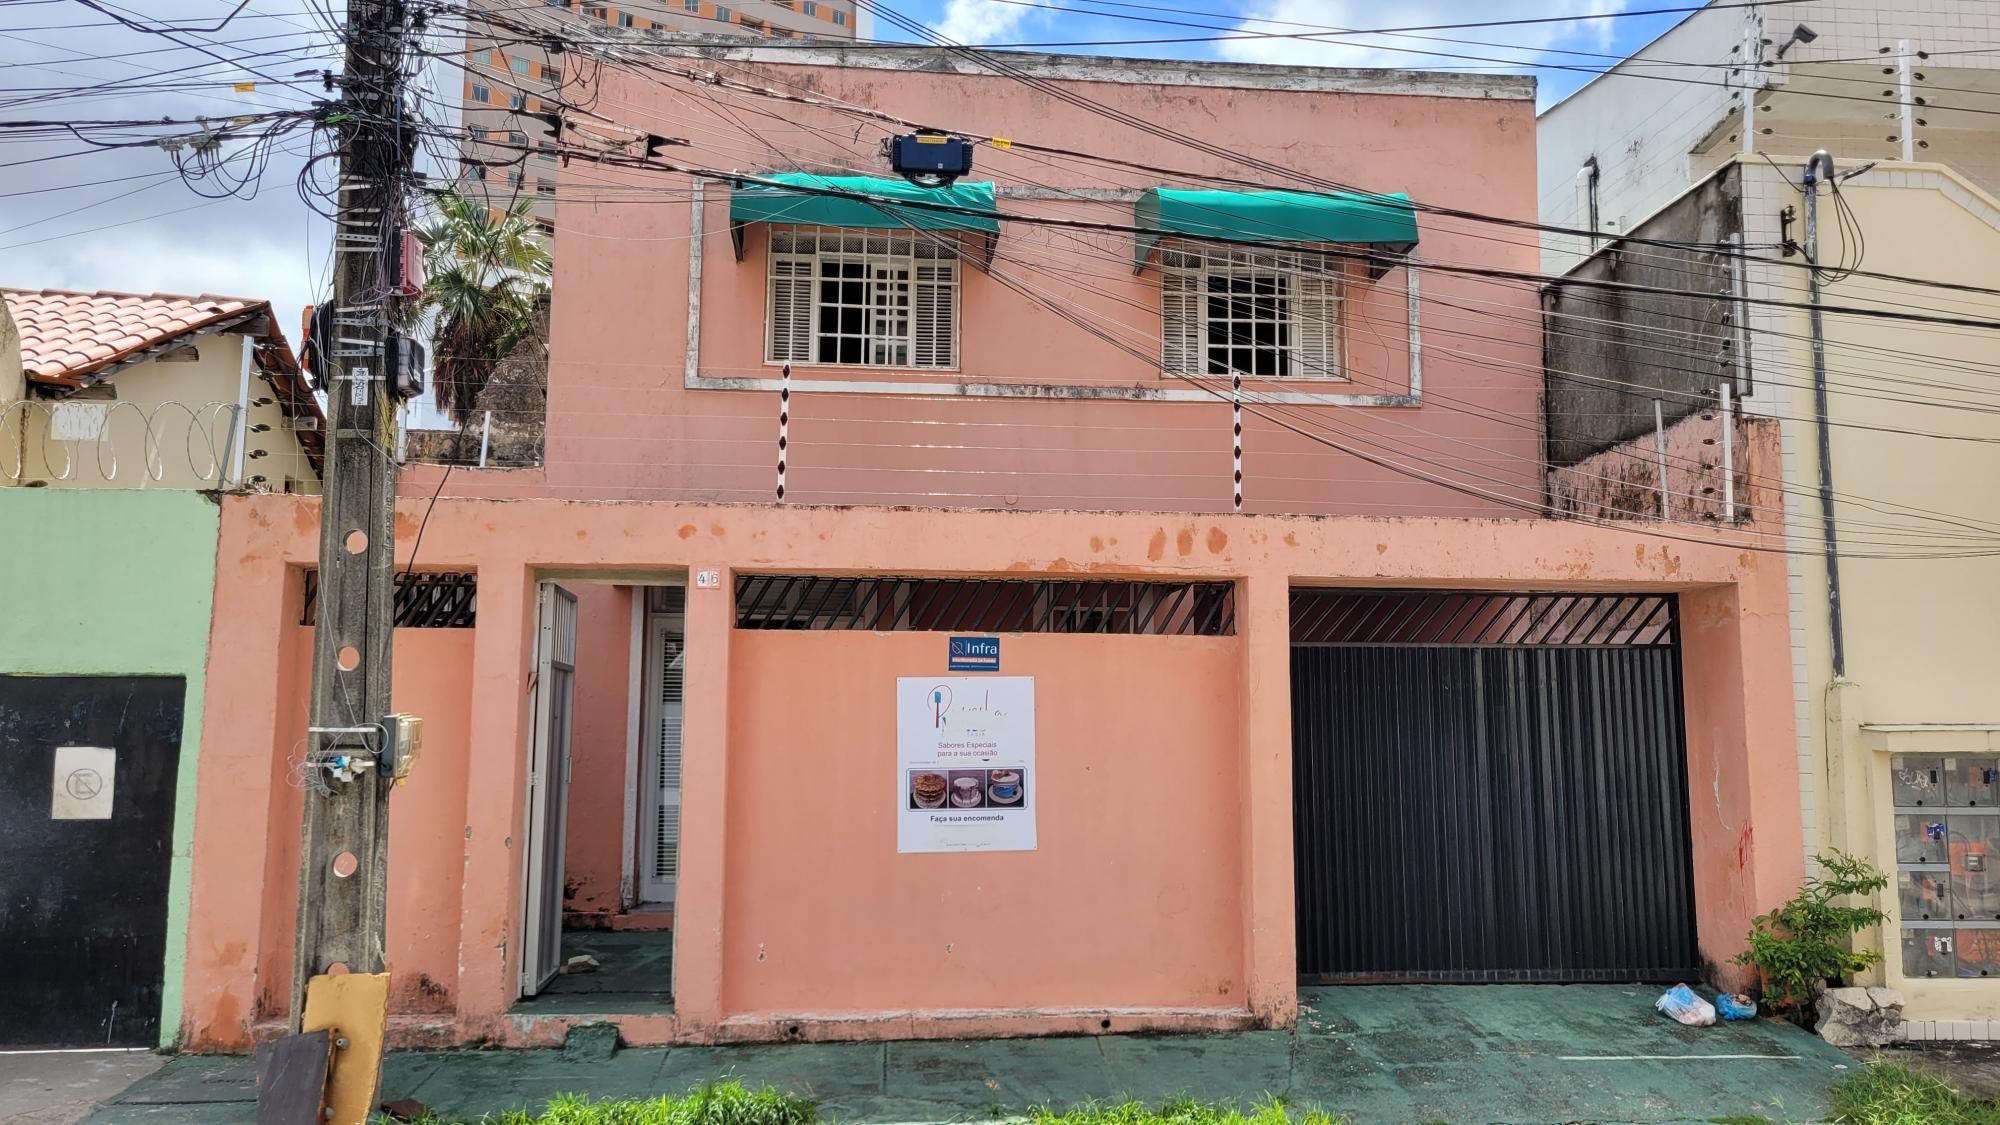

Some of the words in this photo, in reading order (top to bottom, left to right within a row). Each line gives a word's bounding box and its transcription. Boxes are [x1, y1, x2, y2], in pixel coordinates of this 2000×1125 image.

[967, 642, 998, 655] Infra
[937, 741, 965, 749] Sabores
[966, 741, 998, 750] Especiais
[937, 750, 952, 758] para
[972, 749, 998, 757] ocasião
[930, 815, 948, 823] Faça
[963, 814, 1004, 822] encomenda
